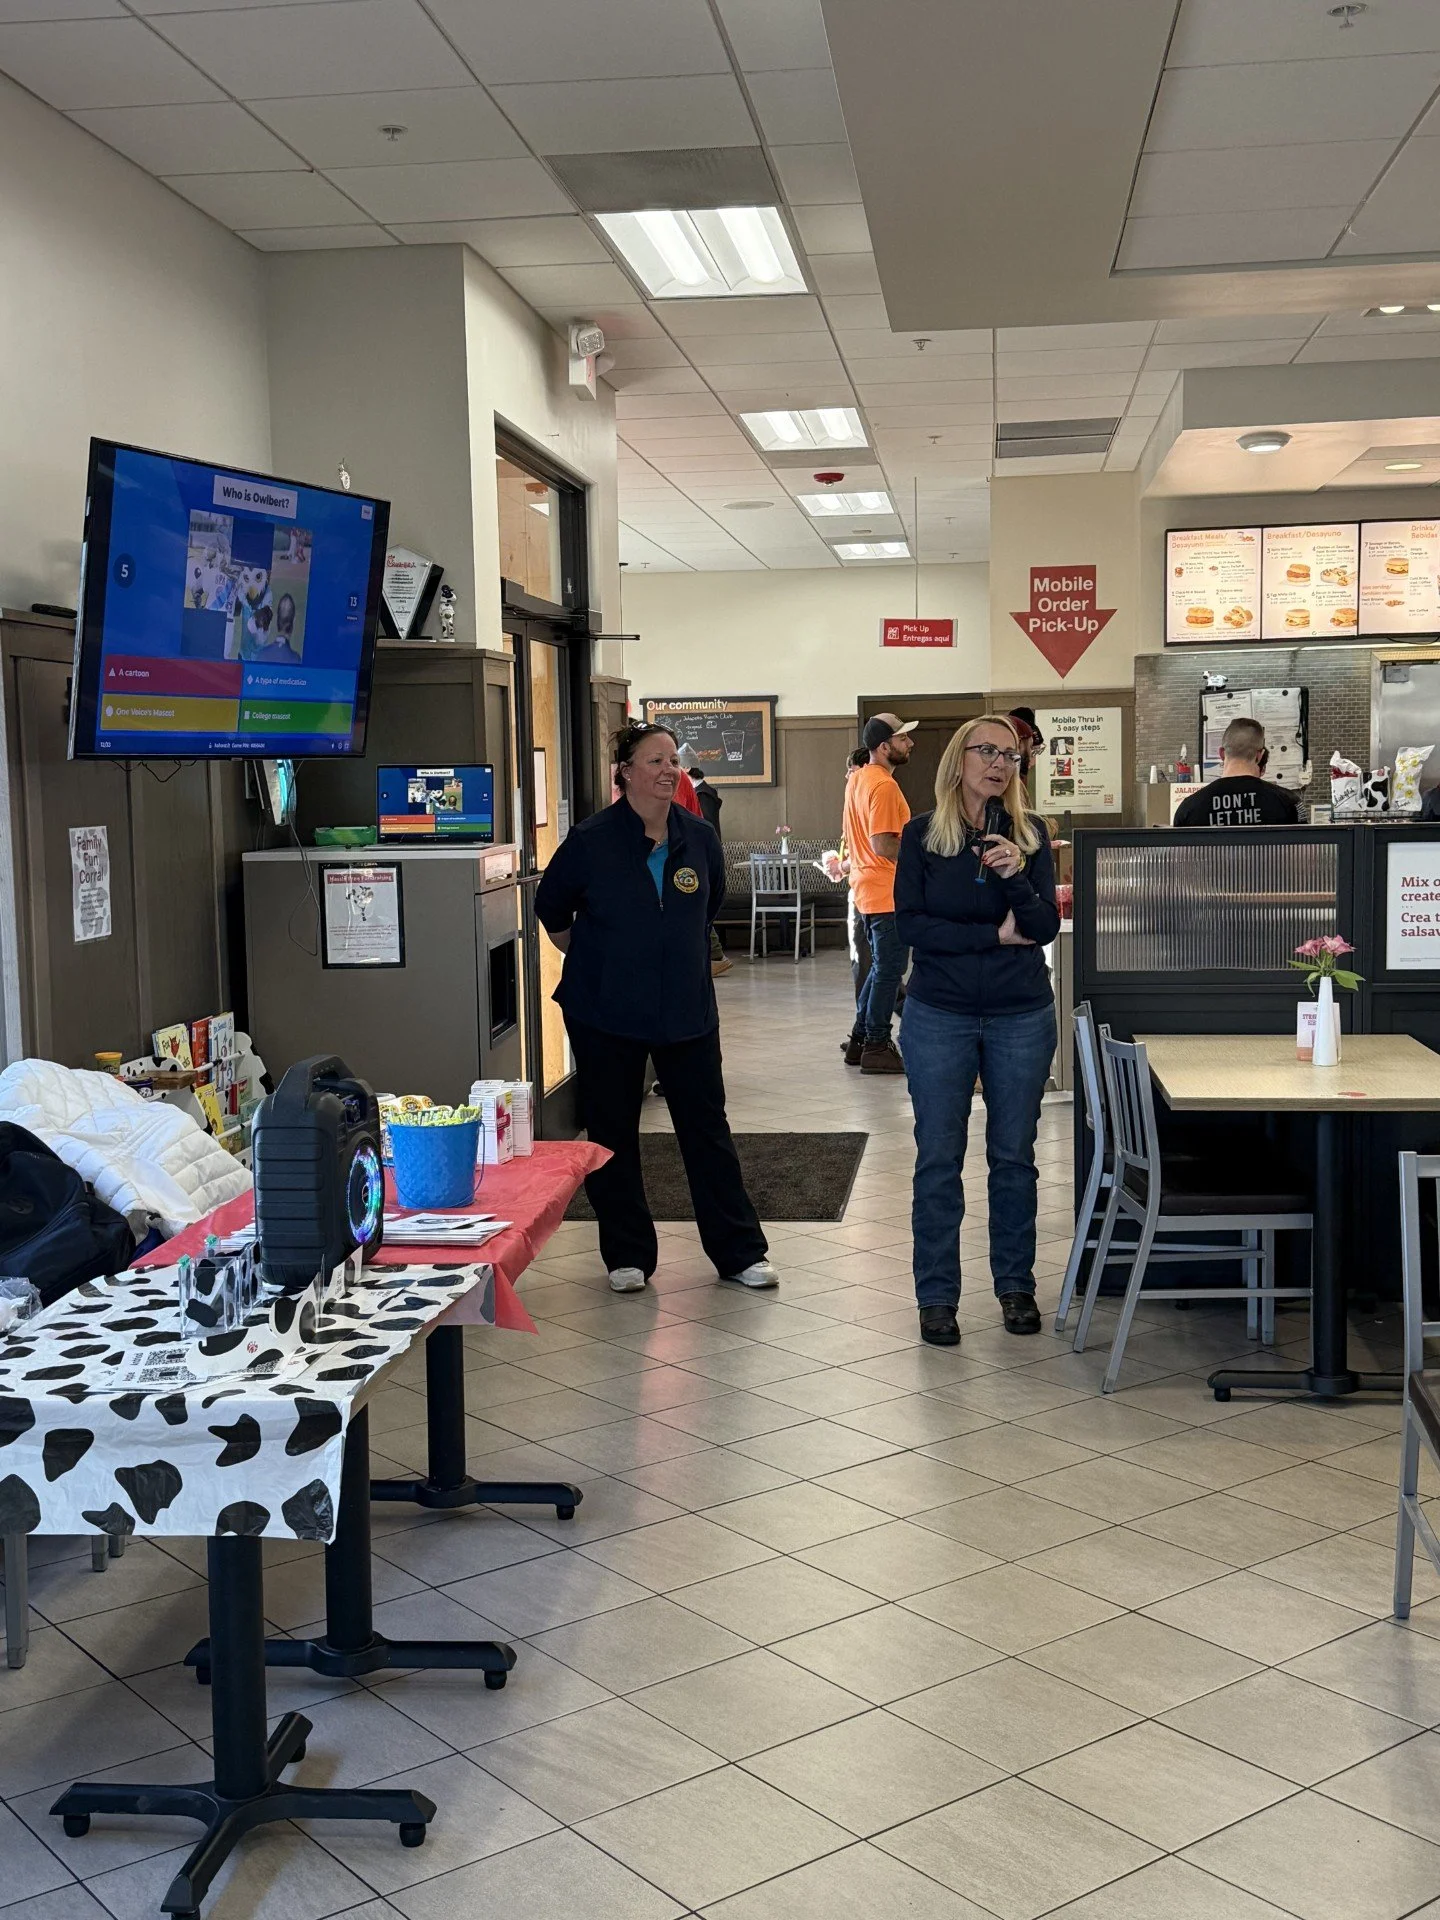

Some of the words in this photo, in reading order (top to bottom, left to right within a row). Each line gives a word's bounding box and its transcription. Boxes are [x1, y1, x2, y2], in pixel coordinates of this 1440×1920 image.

[223, 486, 242, 501] Who
[244, 489, 251, 502] is
[253, 492, 290, 509] Owlbert?
[1171, 533, 1203, 541] Breakfast
[1204, 532, 1229, 540] Meals/
[1171, 541, 1204, 550] Desayuno
[121, 564, 129, 578] 5
[1033, 576, 1093, 593] Mobile
[1037, 597, 1090, 613] Order
[903, 624, 918, 632] Pick
[919, 625, 930, 633] Up
[1028, 616, 1099, 634] Pick-Up
[902, 634, 933, 643] Entregas
[119, 669, 125, 677] A
[125, 669, 150, 678] cartoon
[260, 677, 272, 686] type
[646, 700, 668, 711] Our
[668, 698, 728, 711] community
[116, 707, 130, 716] One
[131, 708, 152, 716] Voice's
[153, 709, 175, 718] Mascot
[252, 711, 272, 721] College
[1051, 716, 1076, 724] Mobile
[1077, 715, 1095, 723] Thru
[1063, 725, 1079, 733] easy
[1080, 724, 1101, 732] steps
[1212, 792, 1257, 811] DON'T
[1209, 810, 1233, 826] LET
[1235, 808, 1262, 825] THE
[77, 834, 102, 851] Family
[83, 852, 99, 867] Fun
[79, 867, 104, 885] Corral
[1401, 876, 1430, 888] Mix
[1401, 912, 1431, 923] Crea
